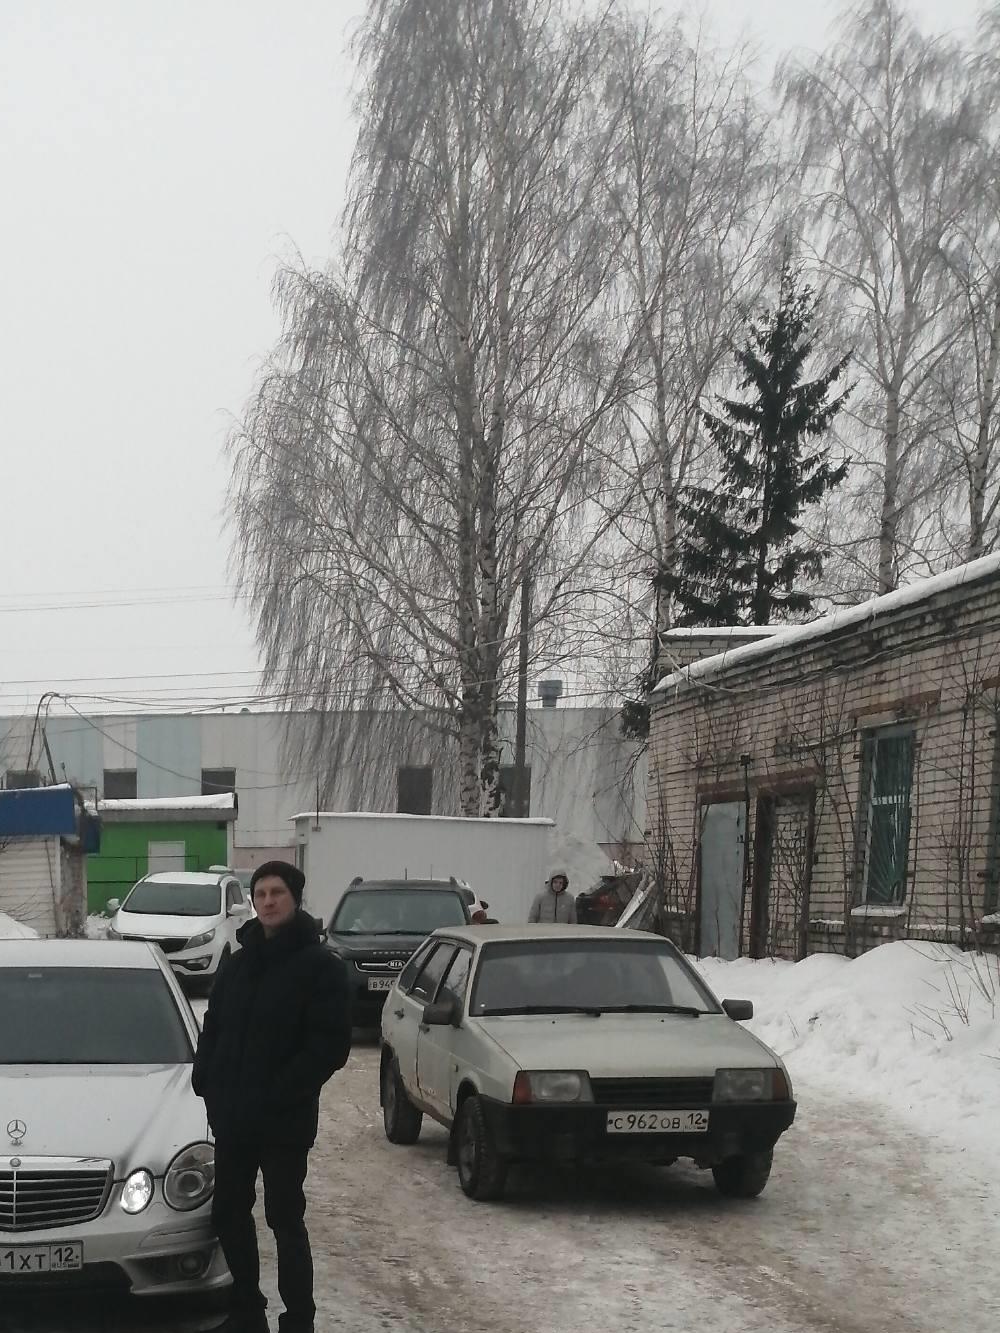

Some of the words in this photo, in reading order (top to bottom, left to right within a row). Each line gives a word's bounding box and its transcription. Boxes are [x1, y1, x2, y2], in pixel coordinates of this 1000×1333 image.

[614, 1114, 681, 1130] С962ОВ
[687, 1113, 703, 1125] 12
[54, 1247, 74, 1262] 12
